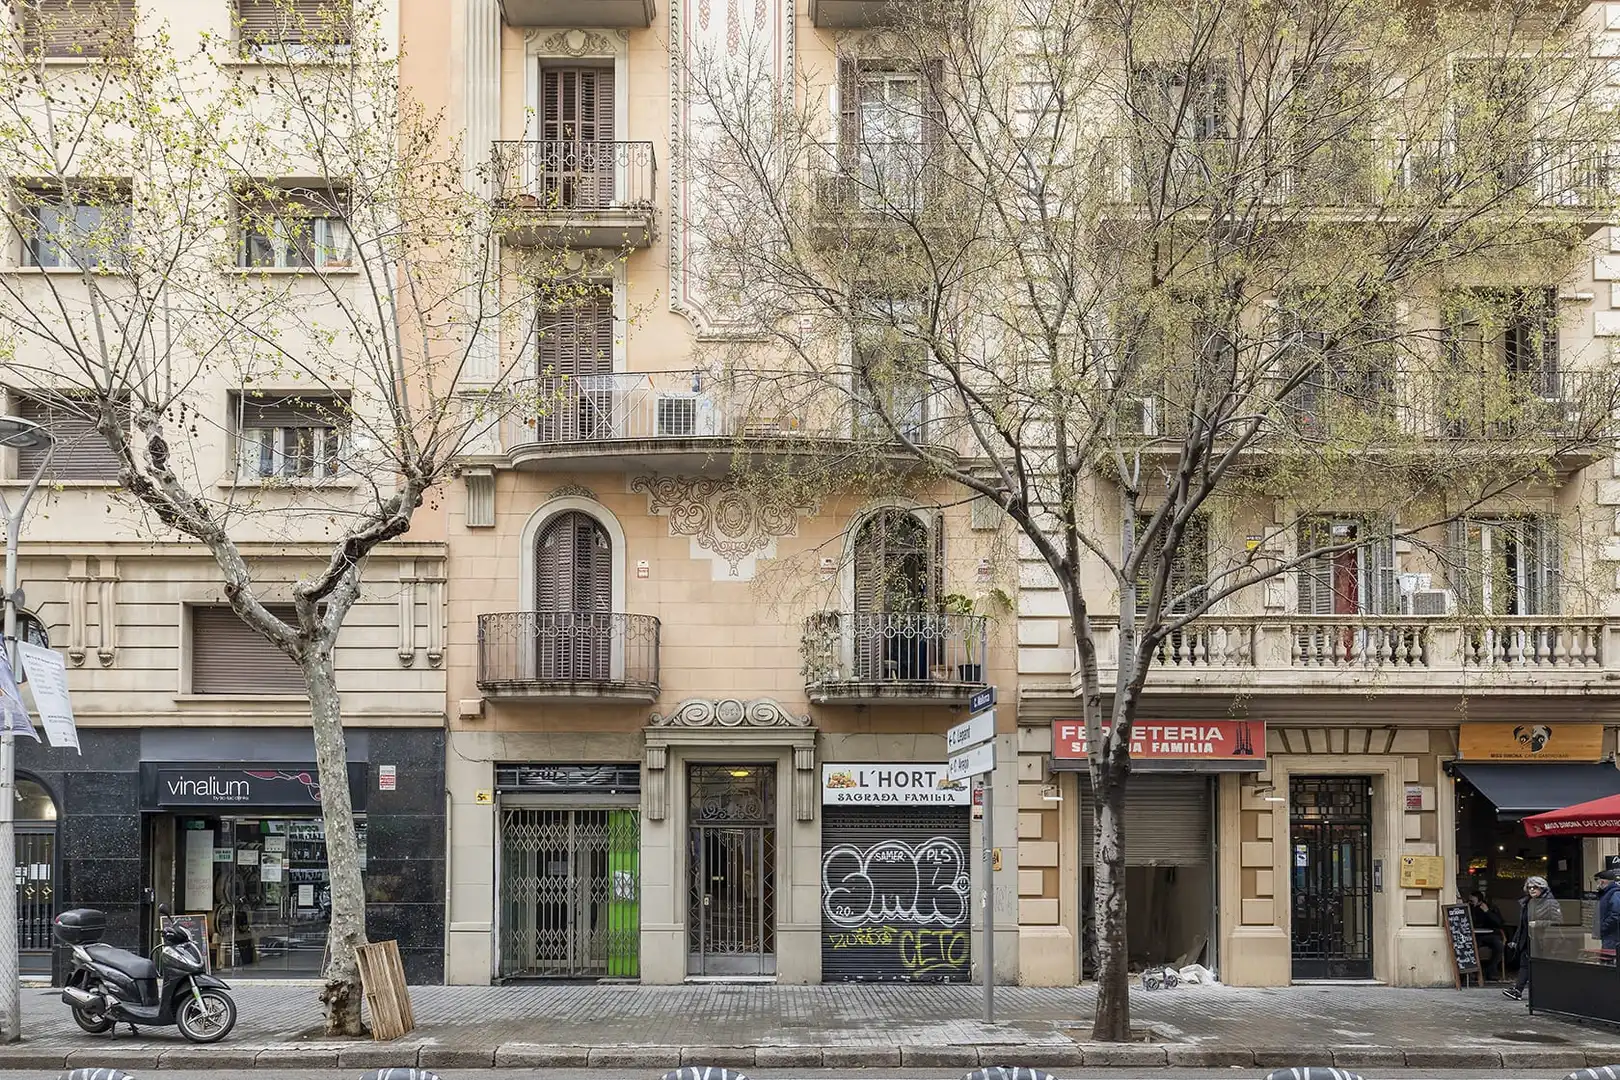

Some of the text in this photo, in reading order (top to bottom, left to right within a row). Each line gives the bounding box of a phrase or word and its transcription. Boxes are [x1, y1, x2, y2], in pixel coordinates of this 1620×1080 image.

[1061, 726, 1224, 740] FEETERIA
[1152, 742, 1213, 753] FAMILIA
[167, 776, 250, 796] vinalium
[837, 793, 956, 802] SAGRADA FAMILIA
[926, 848, 951, 863] PLS
